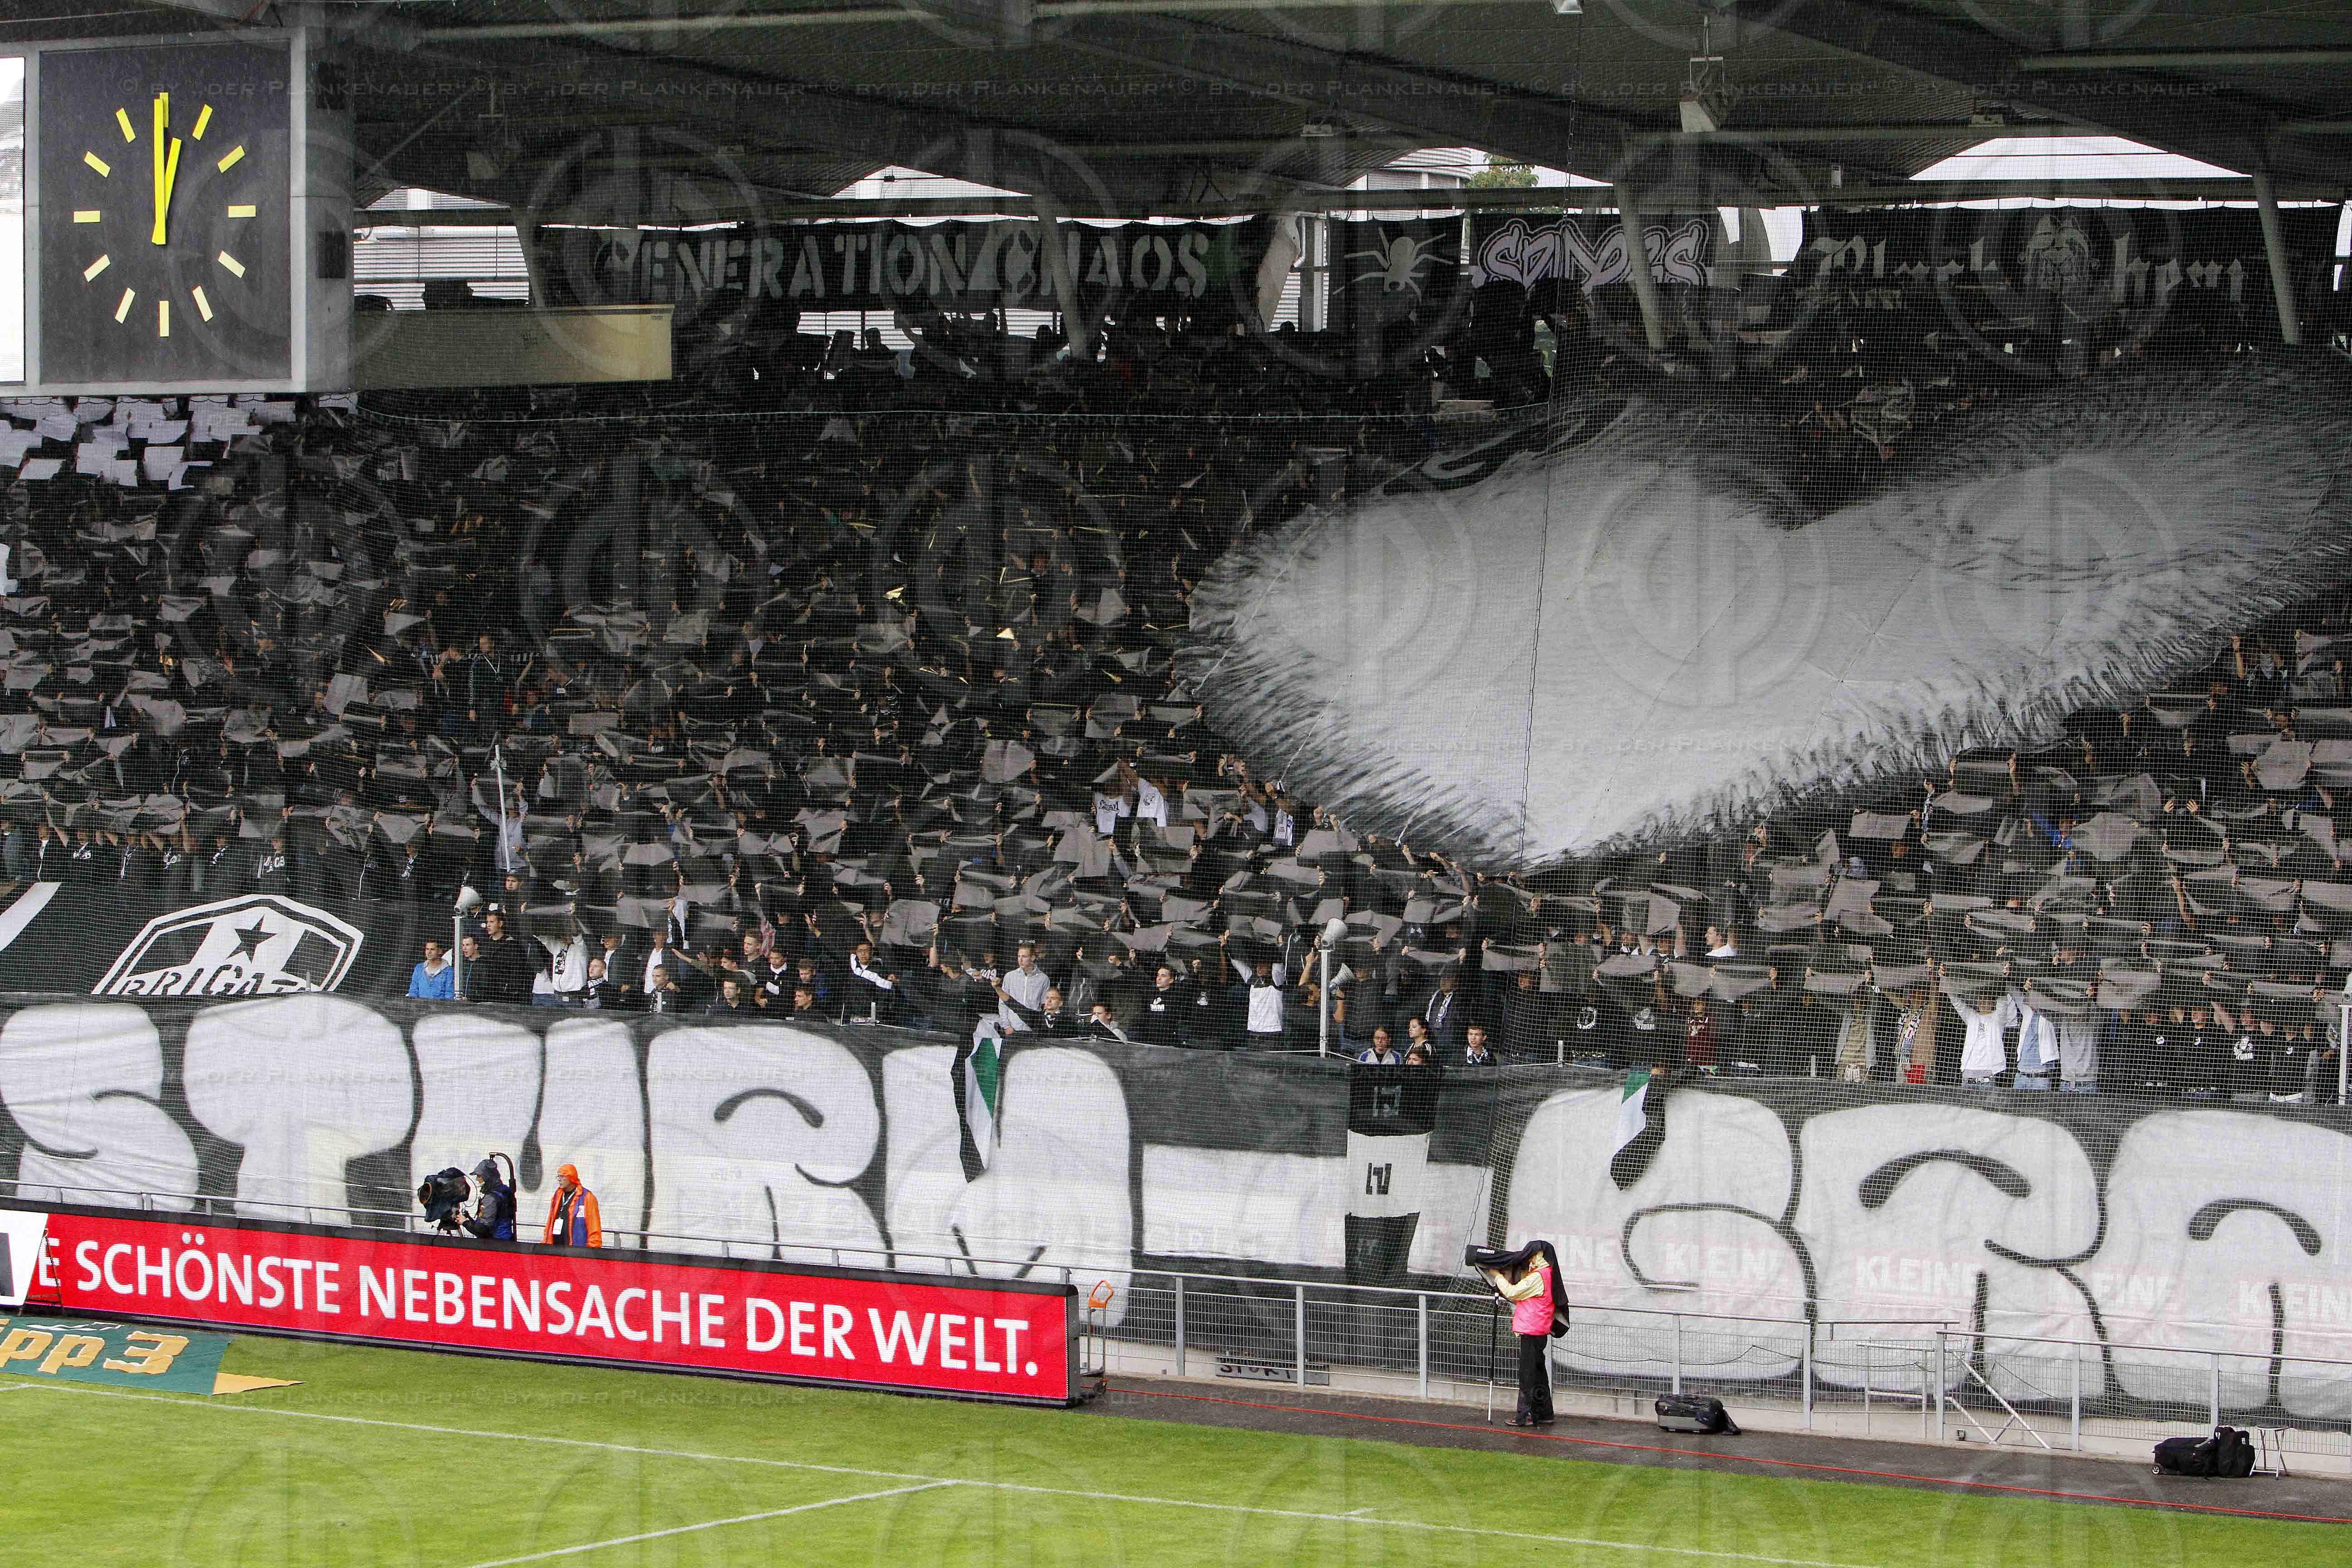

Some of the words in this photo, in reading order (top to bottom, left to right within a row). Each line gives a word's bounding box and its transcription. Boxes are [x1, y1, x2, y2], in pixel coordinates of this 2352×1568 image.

[0, 1318, 190, 1375] pp3
[75, 1232, 340, 1313] SCHÖNSTE
[359, 1264, 725, 1348] NEBENSACHE
[745, 1297, 856, 1360] DER
[867, 1308, 1038, 1377] WELT.
